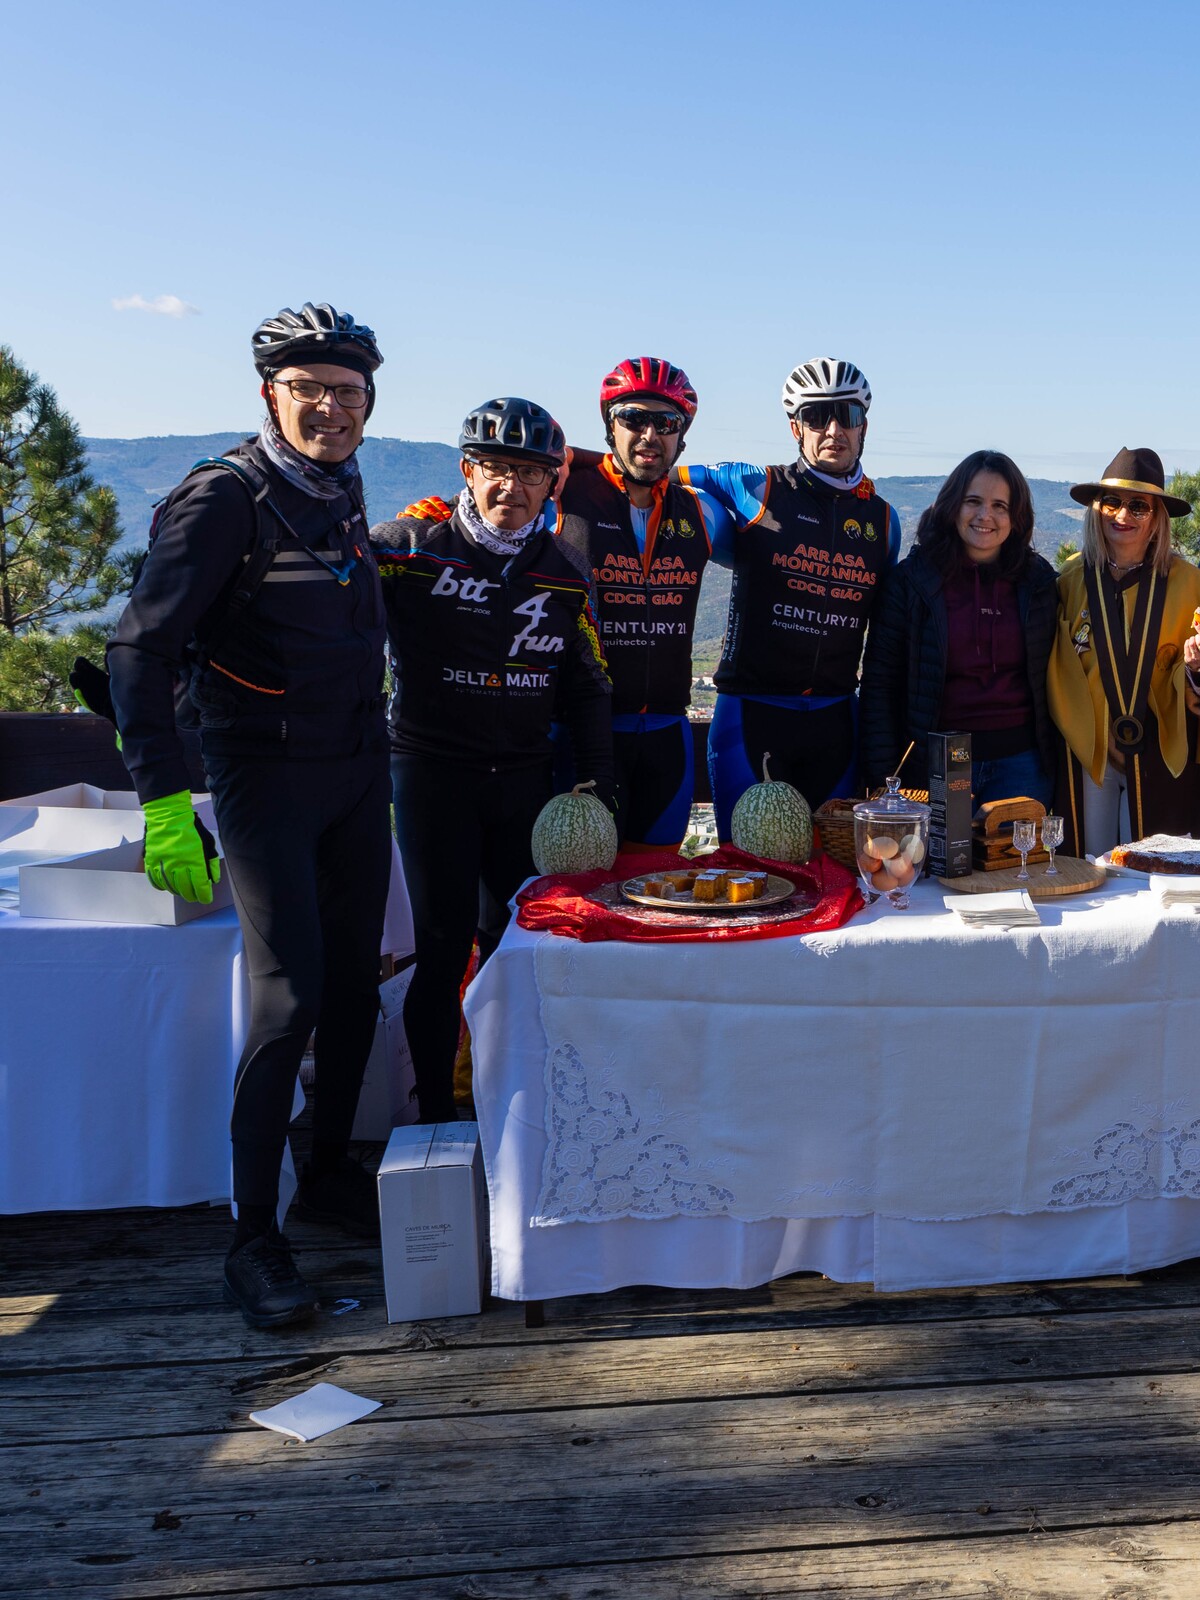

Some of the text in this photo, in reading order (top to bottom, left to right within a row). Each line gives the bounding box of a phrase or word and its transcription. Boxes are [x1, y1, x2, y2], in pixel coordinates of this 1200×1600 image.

[431, 566, 501, 603] btt
[787, 578, 863, 602] CDCR GIÃO
[603, 592, 683, 606] CDCR GIÃO
[603, 621, 687, 635] ENTURY 21
[773, 603, 860, 629] CENTURY 21
[508, 621, 565, 657] fun
[602, 638, 656, 648] quitectos
